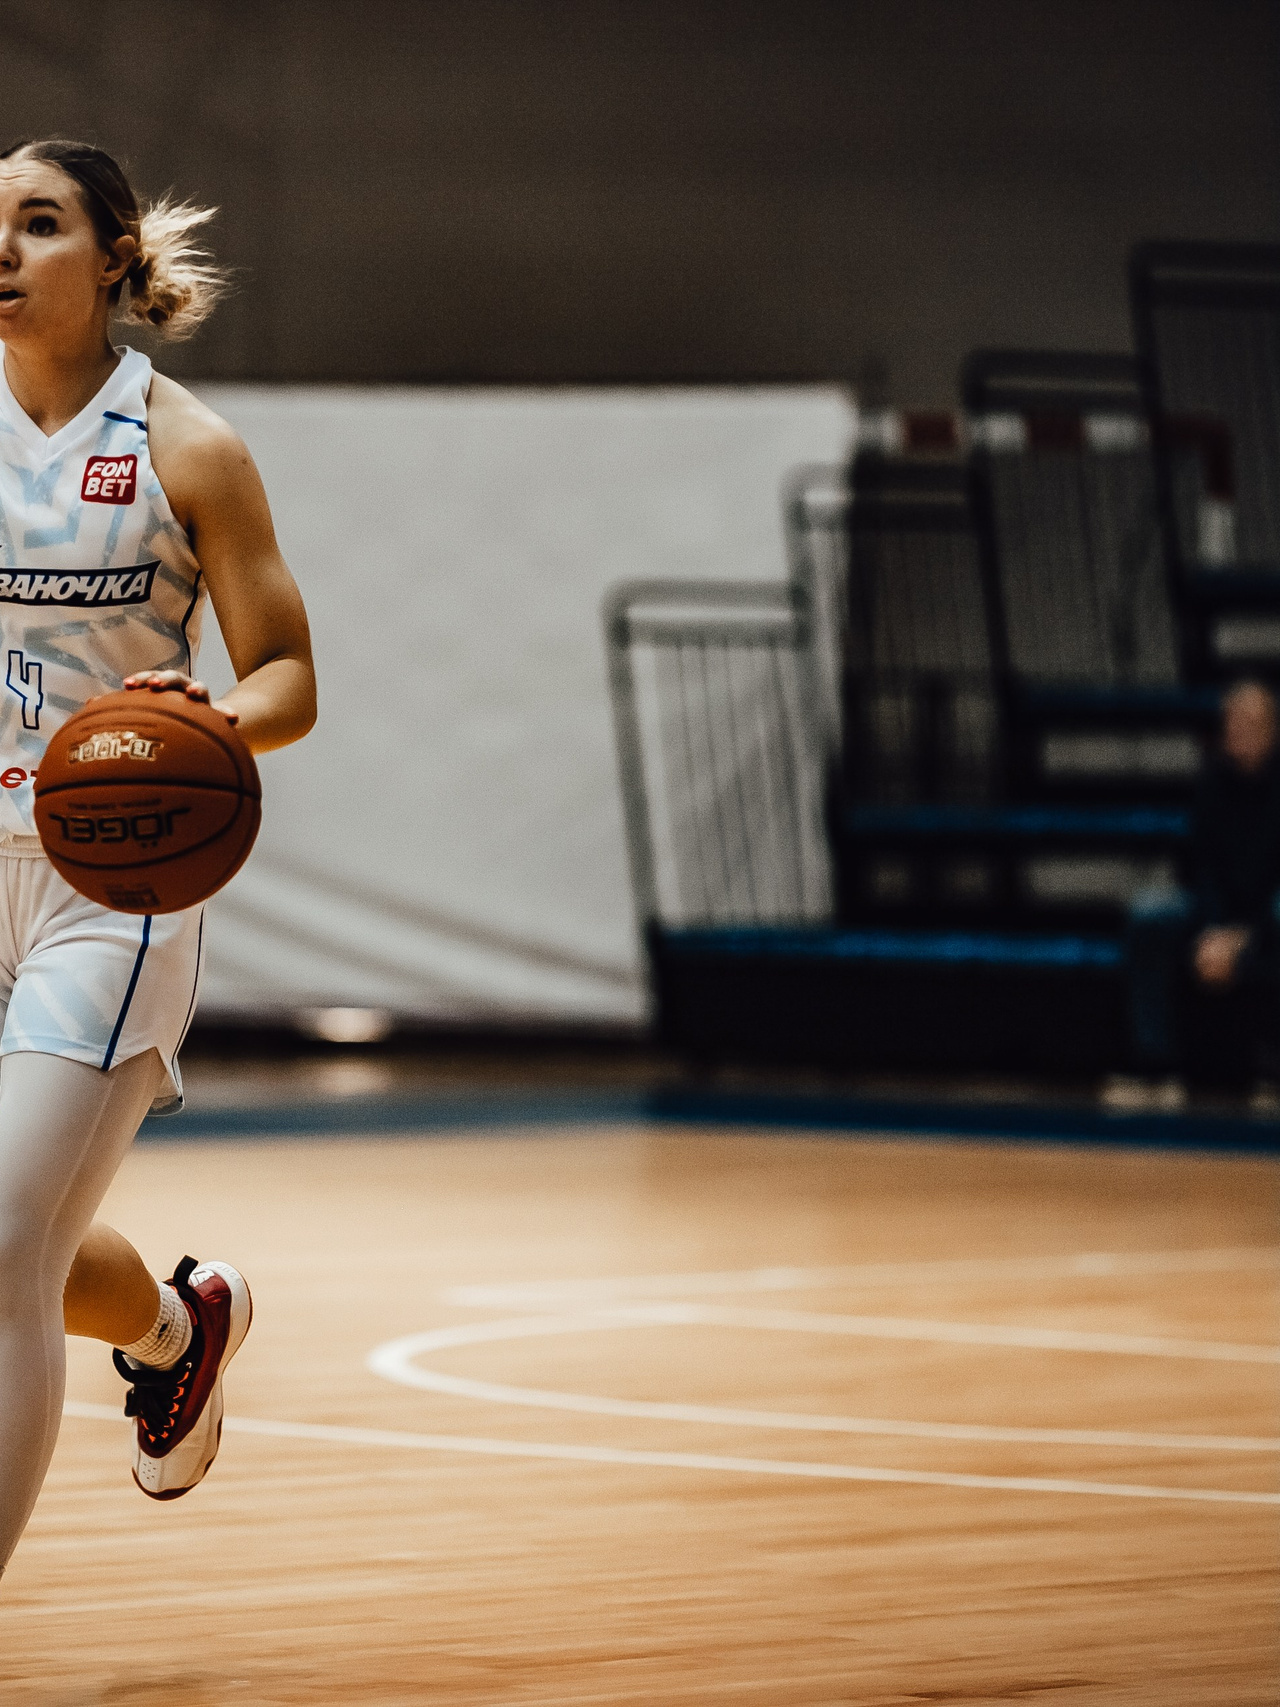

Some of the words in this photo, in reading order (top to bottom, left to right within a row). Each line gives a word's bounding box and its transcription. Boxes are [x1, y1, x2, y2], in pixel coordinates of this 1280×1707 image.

[87, 460, 133, 478] FON
[84, 477, 132, 498] BET
[6, 650, 43, 730] 4
[47, 806, 191, 850] JÖGEL
